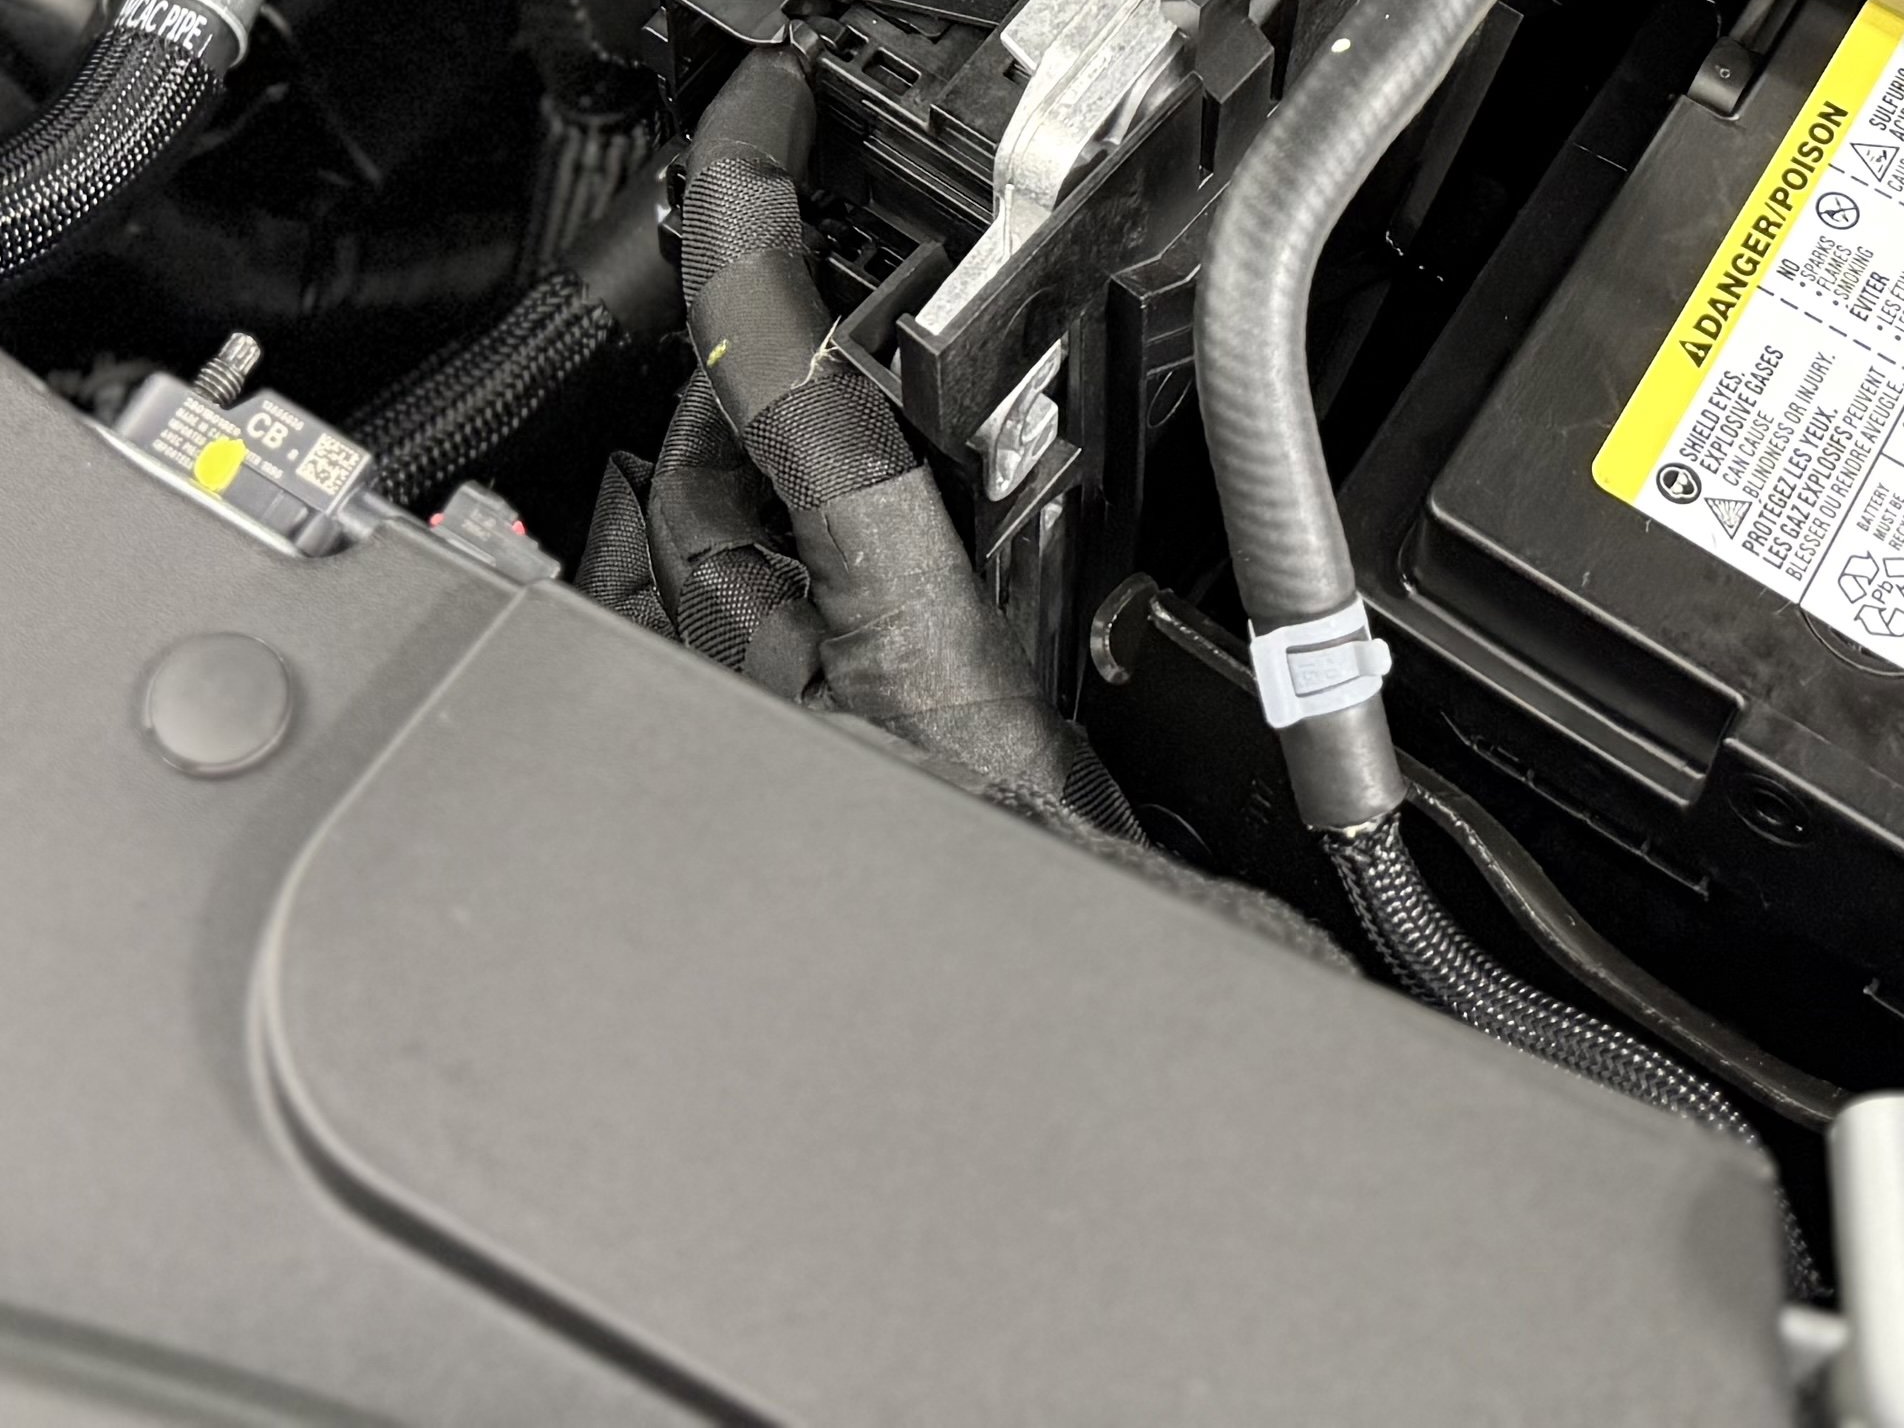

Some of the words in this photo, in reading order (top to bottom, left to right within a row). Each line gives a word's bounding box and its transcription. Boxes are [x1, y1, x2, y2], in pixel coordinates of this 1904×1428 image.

[157, 2, 208, 50] PIPE
[1694, 102, 1847, 339] DANGER/POISON
[1776, 258, 1800, 281] NO
[1800, 235, 1836, 282] SPARKS
[1816, 244, 1852, 292] FLAMES
[1833, 246, 1874, 300] SMOKING
[1845, 268, 1890, 322] ÉVITER
[1876, 299, 1902, 326] LES
[1795, 351, 1836, 404] INJURY.
[247, 411, 289, 449] CB
[1679, 409, 1720, 462] SHIELD
[1708, 370, 1745, 411] EYES.
[1699, 392, 1757, 475] EXPLOSIVE
[1744, 345, 1784, 395] GASES
[1783, 401, 1808, 424] OR
[1722, 455, 1750, 487] CAN
[1738, 410, 1775, 457] CAUSE
[1742, 422, 1795, 499] BLINDNESS
[1762, 536, 1793, 570] LES
[1779, 504, 1811, 540] GAZ
[1797, 425, 1853, 508] EXPLOSIFS
[1842, 365, 1886, 429] PEUVENT
[1830, 440, 1872, 498] RENDRE
[1741, 476, 1797, 556] PROTÉGEZ
[1783, 447, 1813, 480] LES
[1819, 494, 1842, 519] OU
[1856, 482, 1890, 532] BATTERY
[1872, 508, 1897, 542] MUST
[1785, 517, 1831, 582] BLESSER
[1871, 580, 1897, 605] Pb
